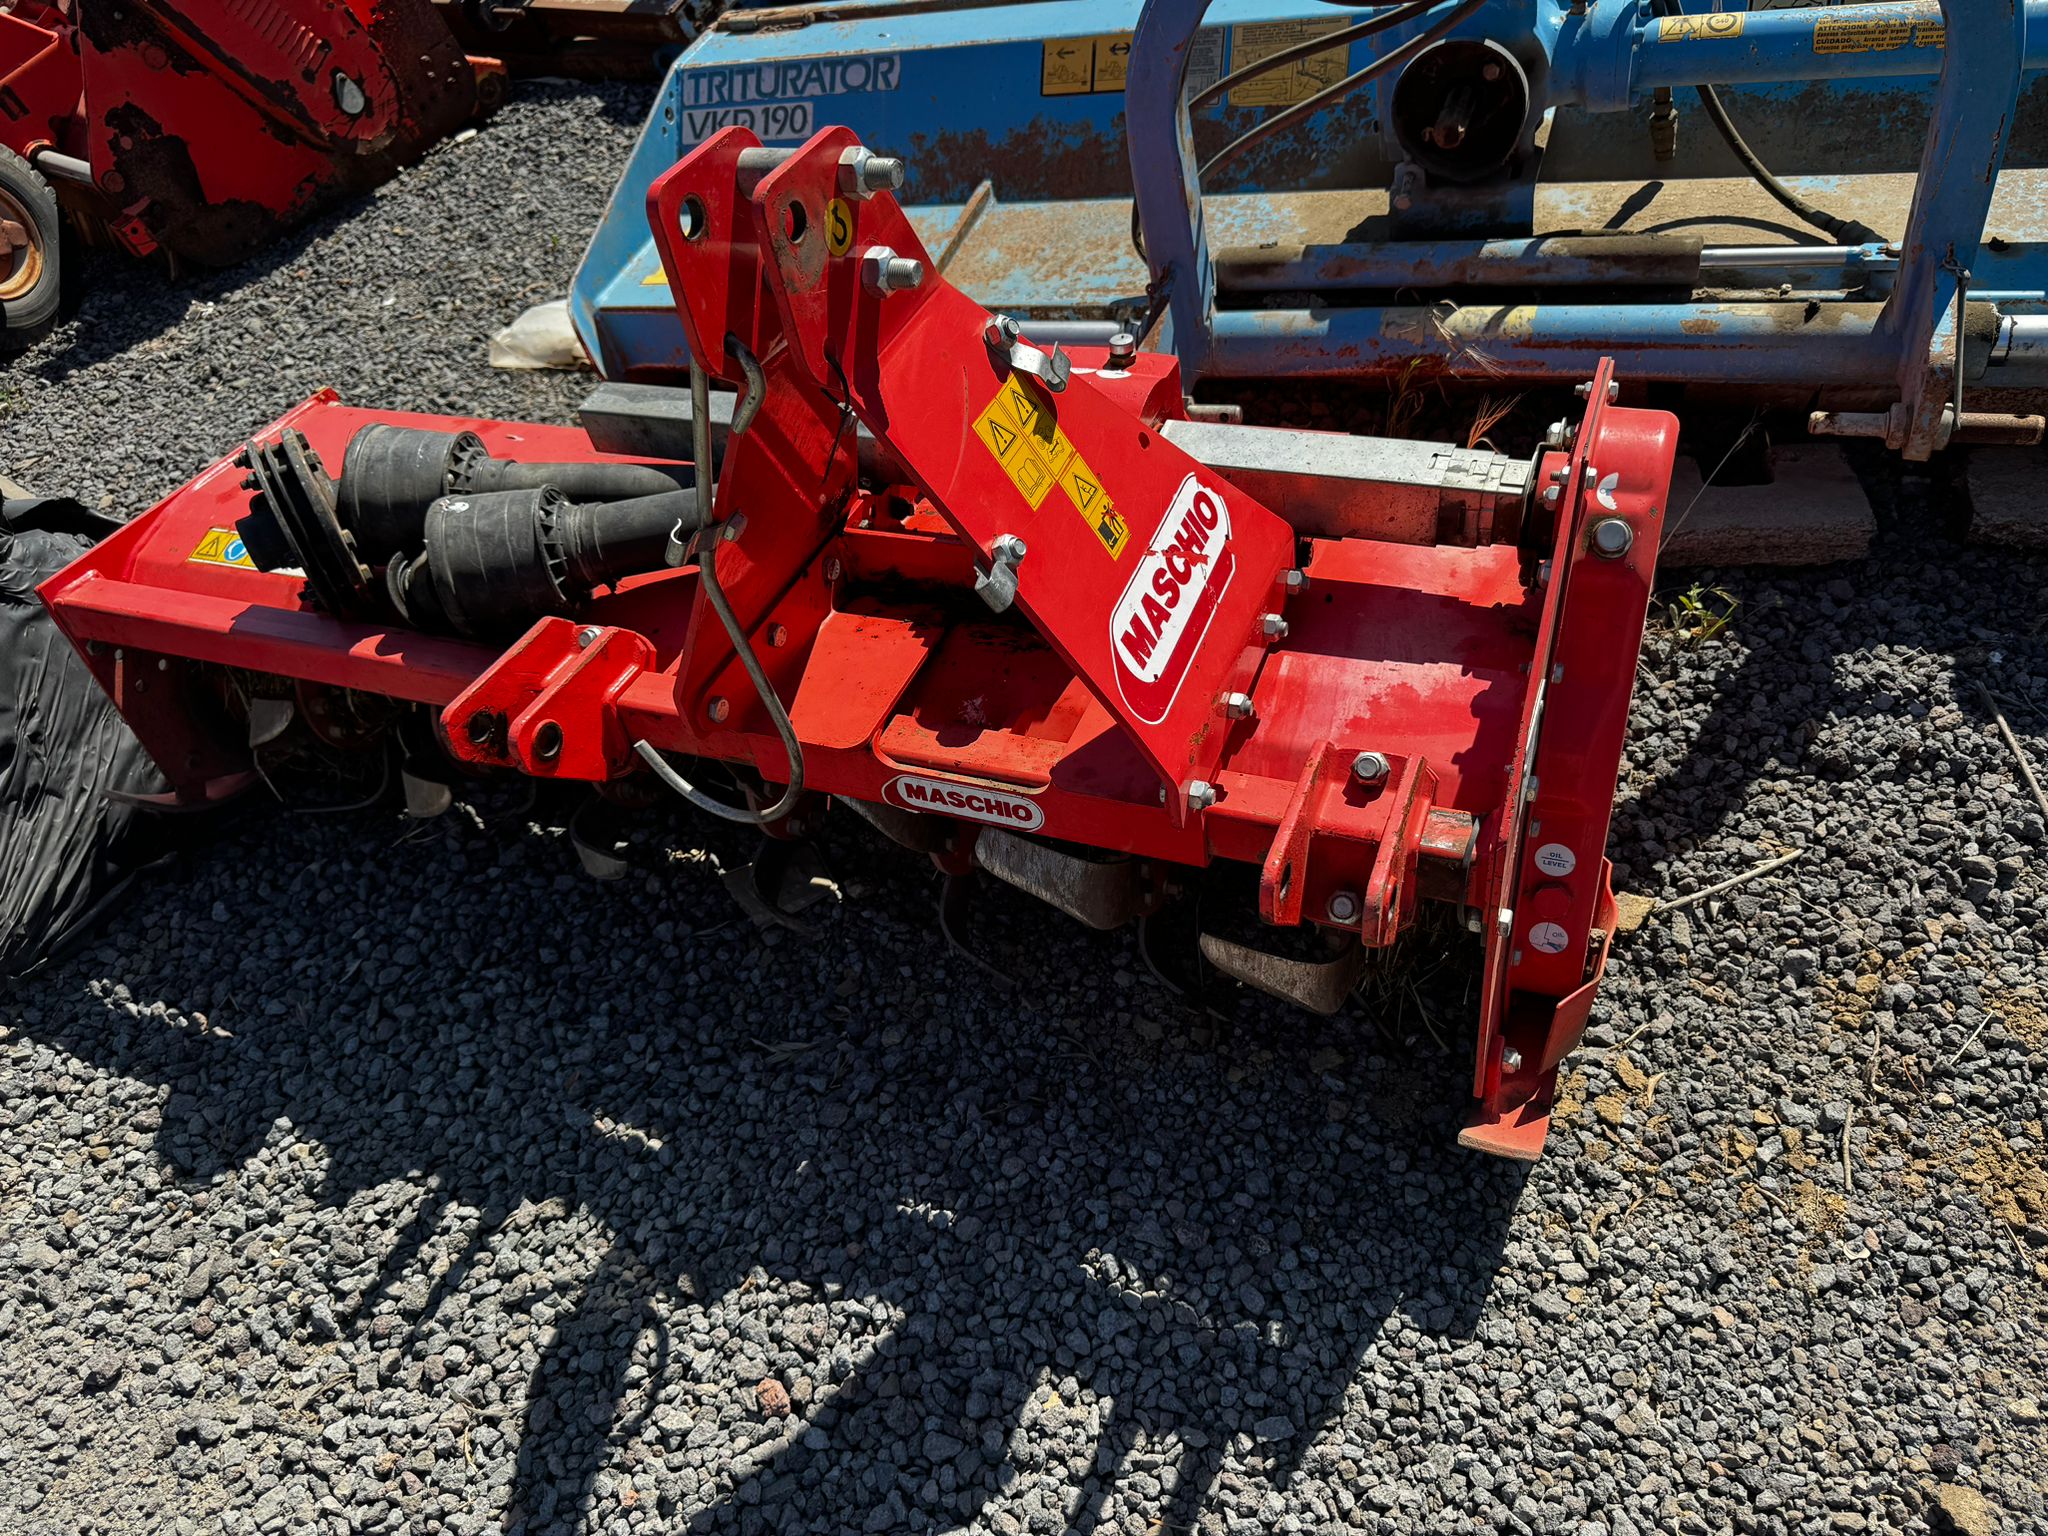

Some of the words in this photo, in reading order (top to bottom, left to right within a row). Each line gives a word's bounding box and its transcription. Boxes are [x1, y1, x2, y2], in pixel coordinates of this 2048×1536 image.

[1816, 37, 1852, 45] CUIDADO
[1818, 24, 1868, 32] ATTENZIONE
[687, 56, 895, 105] TRITURATOR
[687, 108, 756, 140] VKD
[762, 104, 808, 136] 190
[1120, 490, 1218, 672] MASCHIO
[904, 782, 1033, 822] MASCHIO
[1543, 859, 1567, 869] LEVEL
